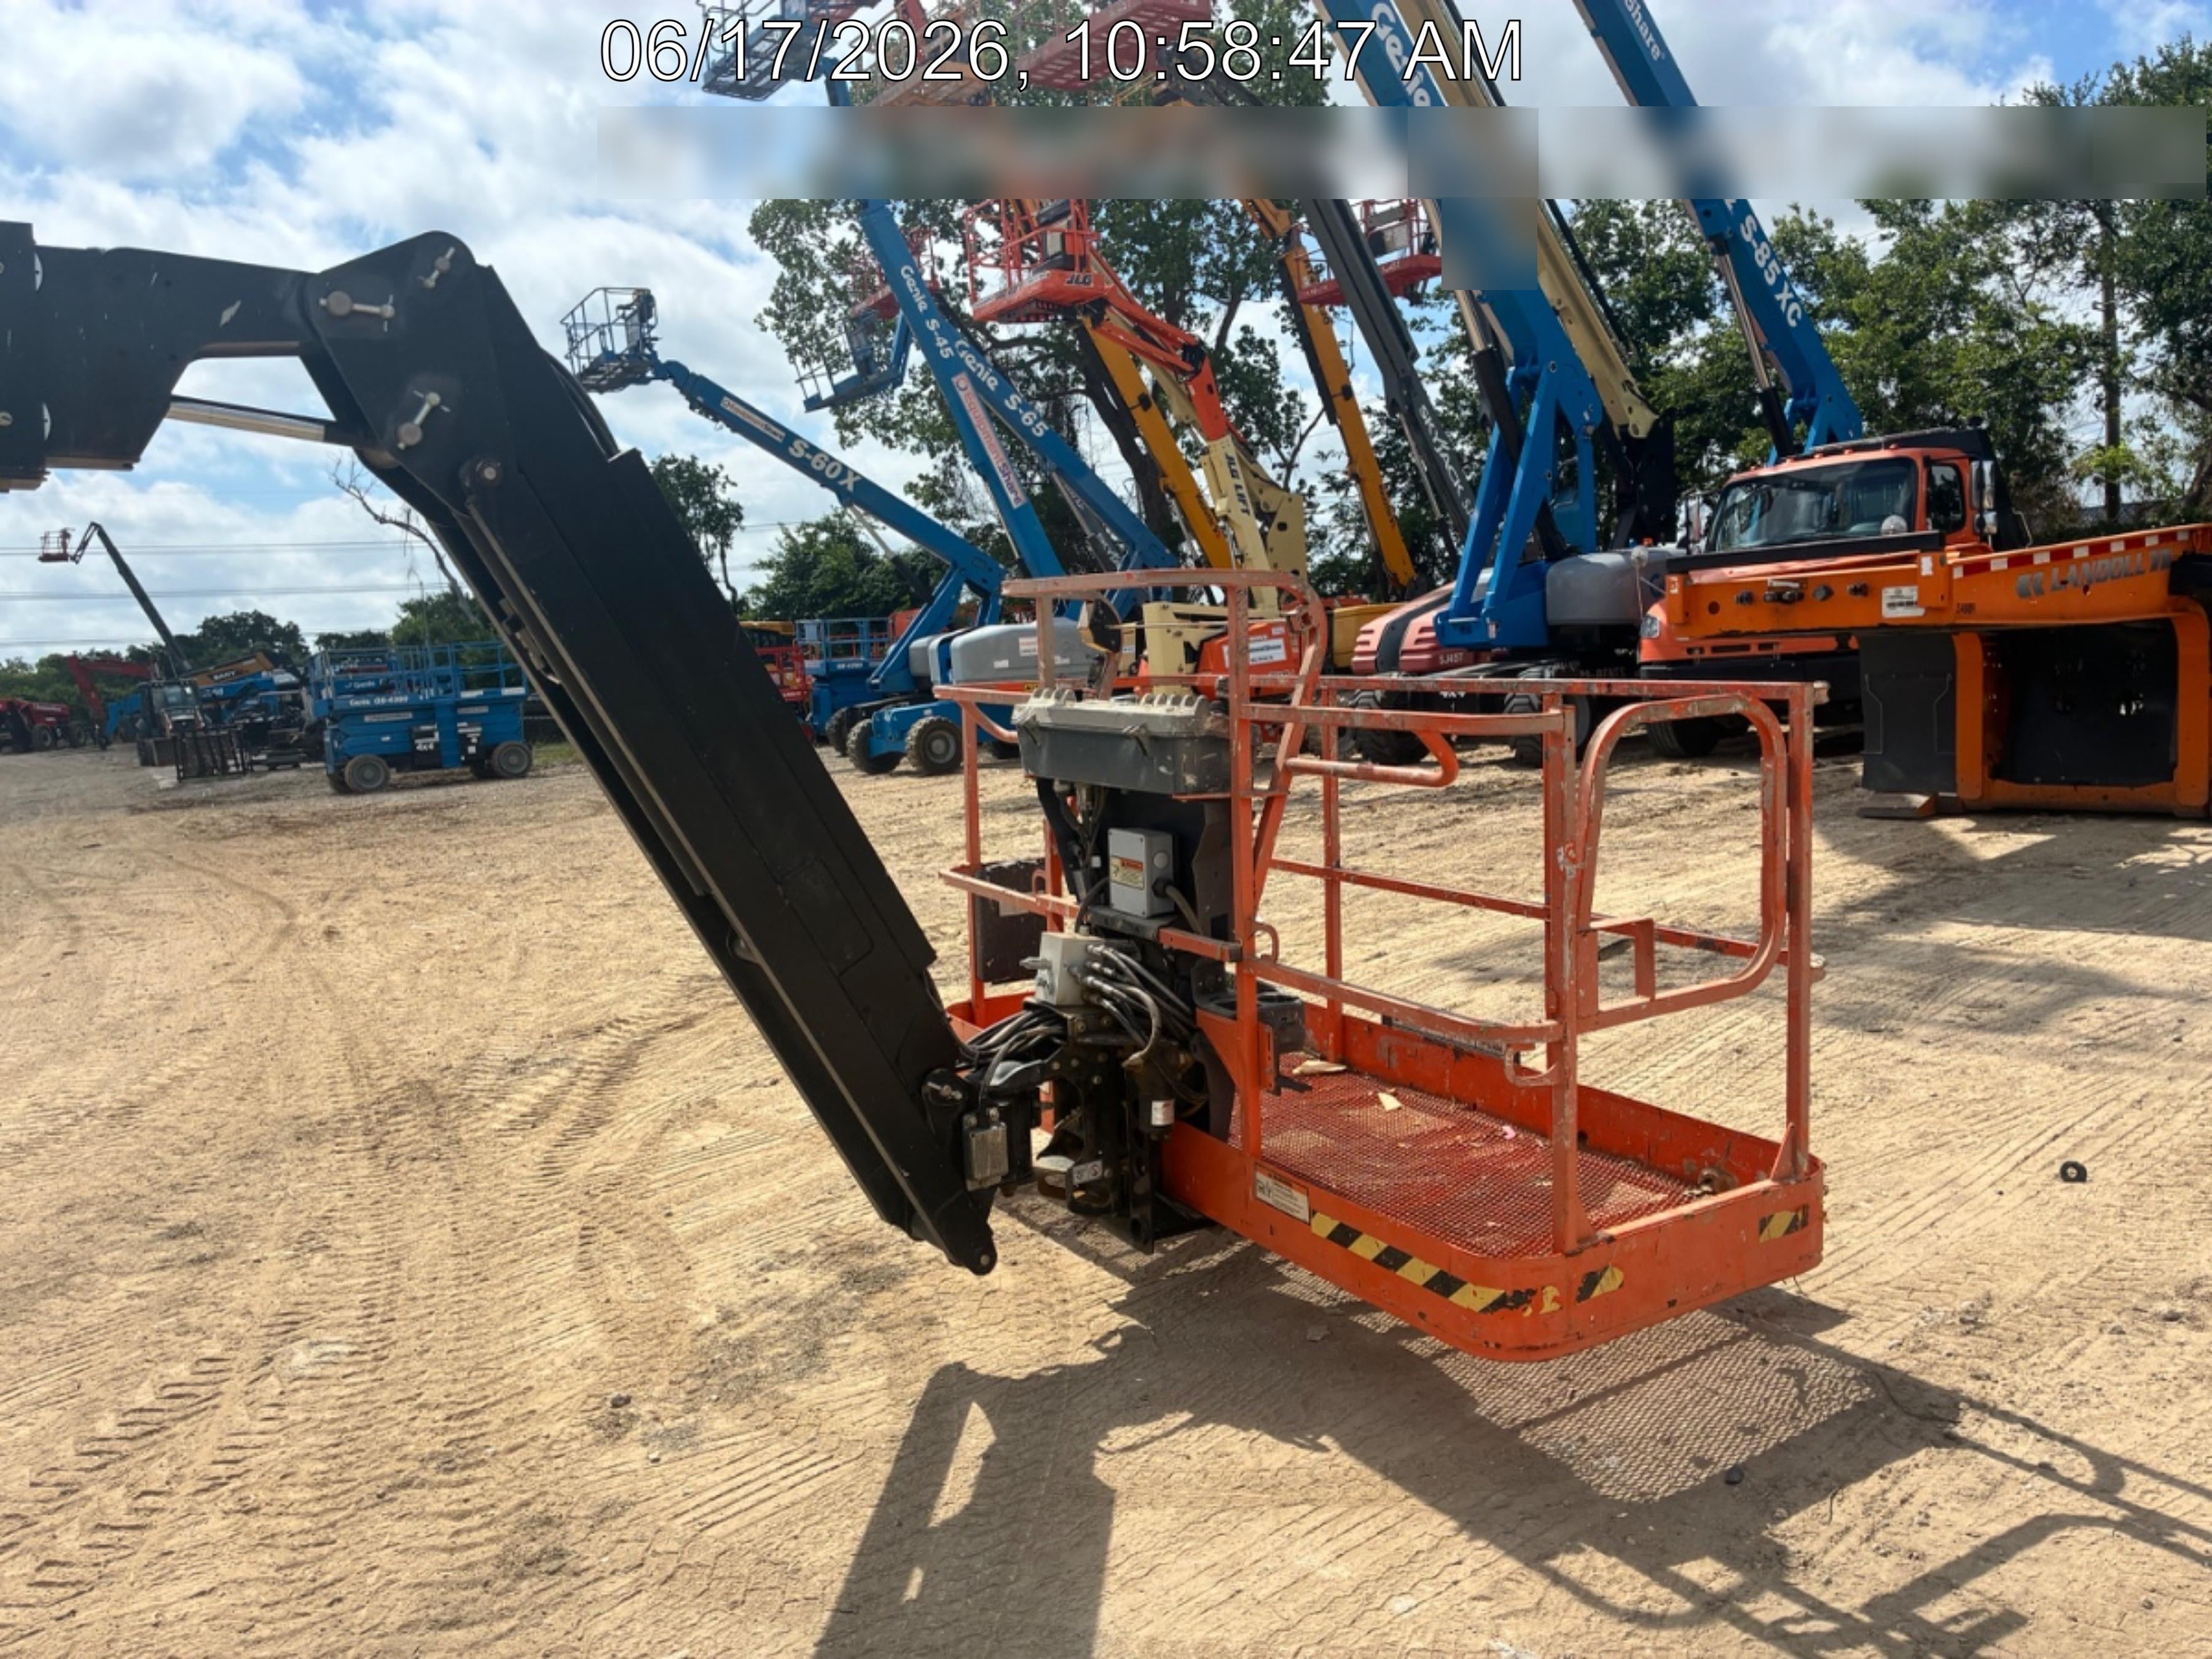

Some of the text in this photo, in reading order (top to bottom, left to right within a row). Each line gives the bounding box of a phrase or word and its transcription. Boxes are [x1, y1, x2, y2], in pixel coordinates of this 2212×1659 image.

[1066, 273, 1092, 285] JLG
[1740, 214, 1802, 327] S-85 XC
[901, 265, 955, 359] Genie S-45
[954, 337, 1049, 438] Genie S-65
[1225, 452, 1250, 516] JLG LIFT
[2050, 552, 2147, 592] LANDOLL
